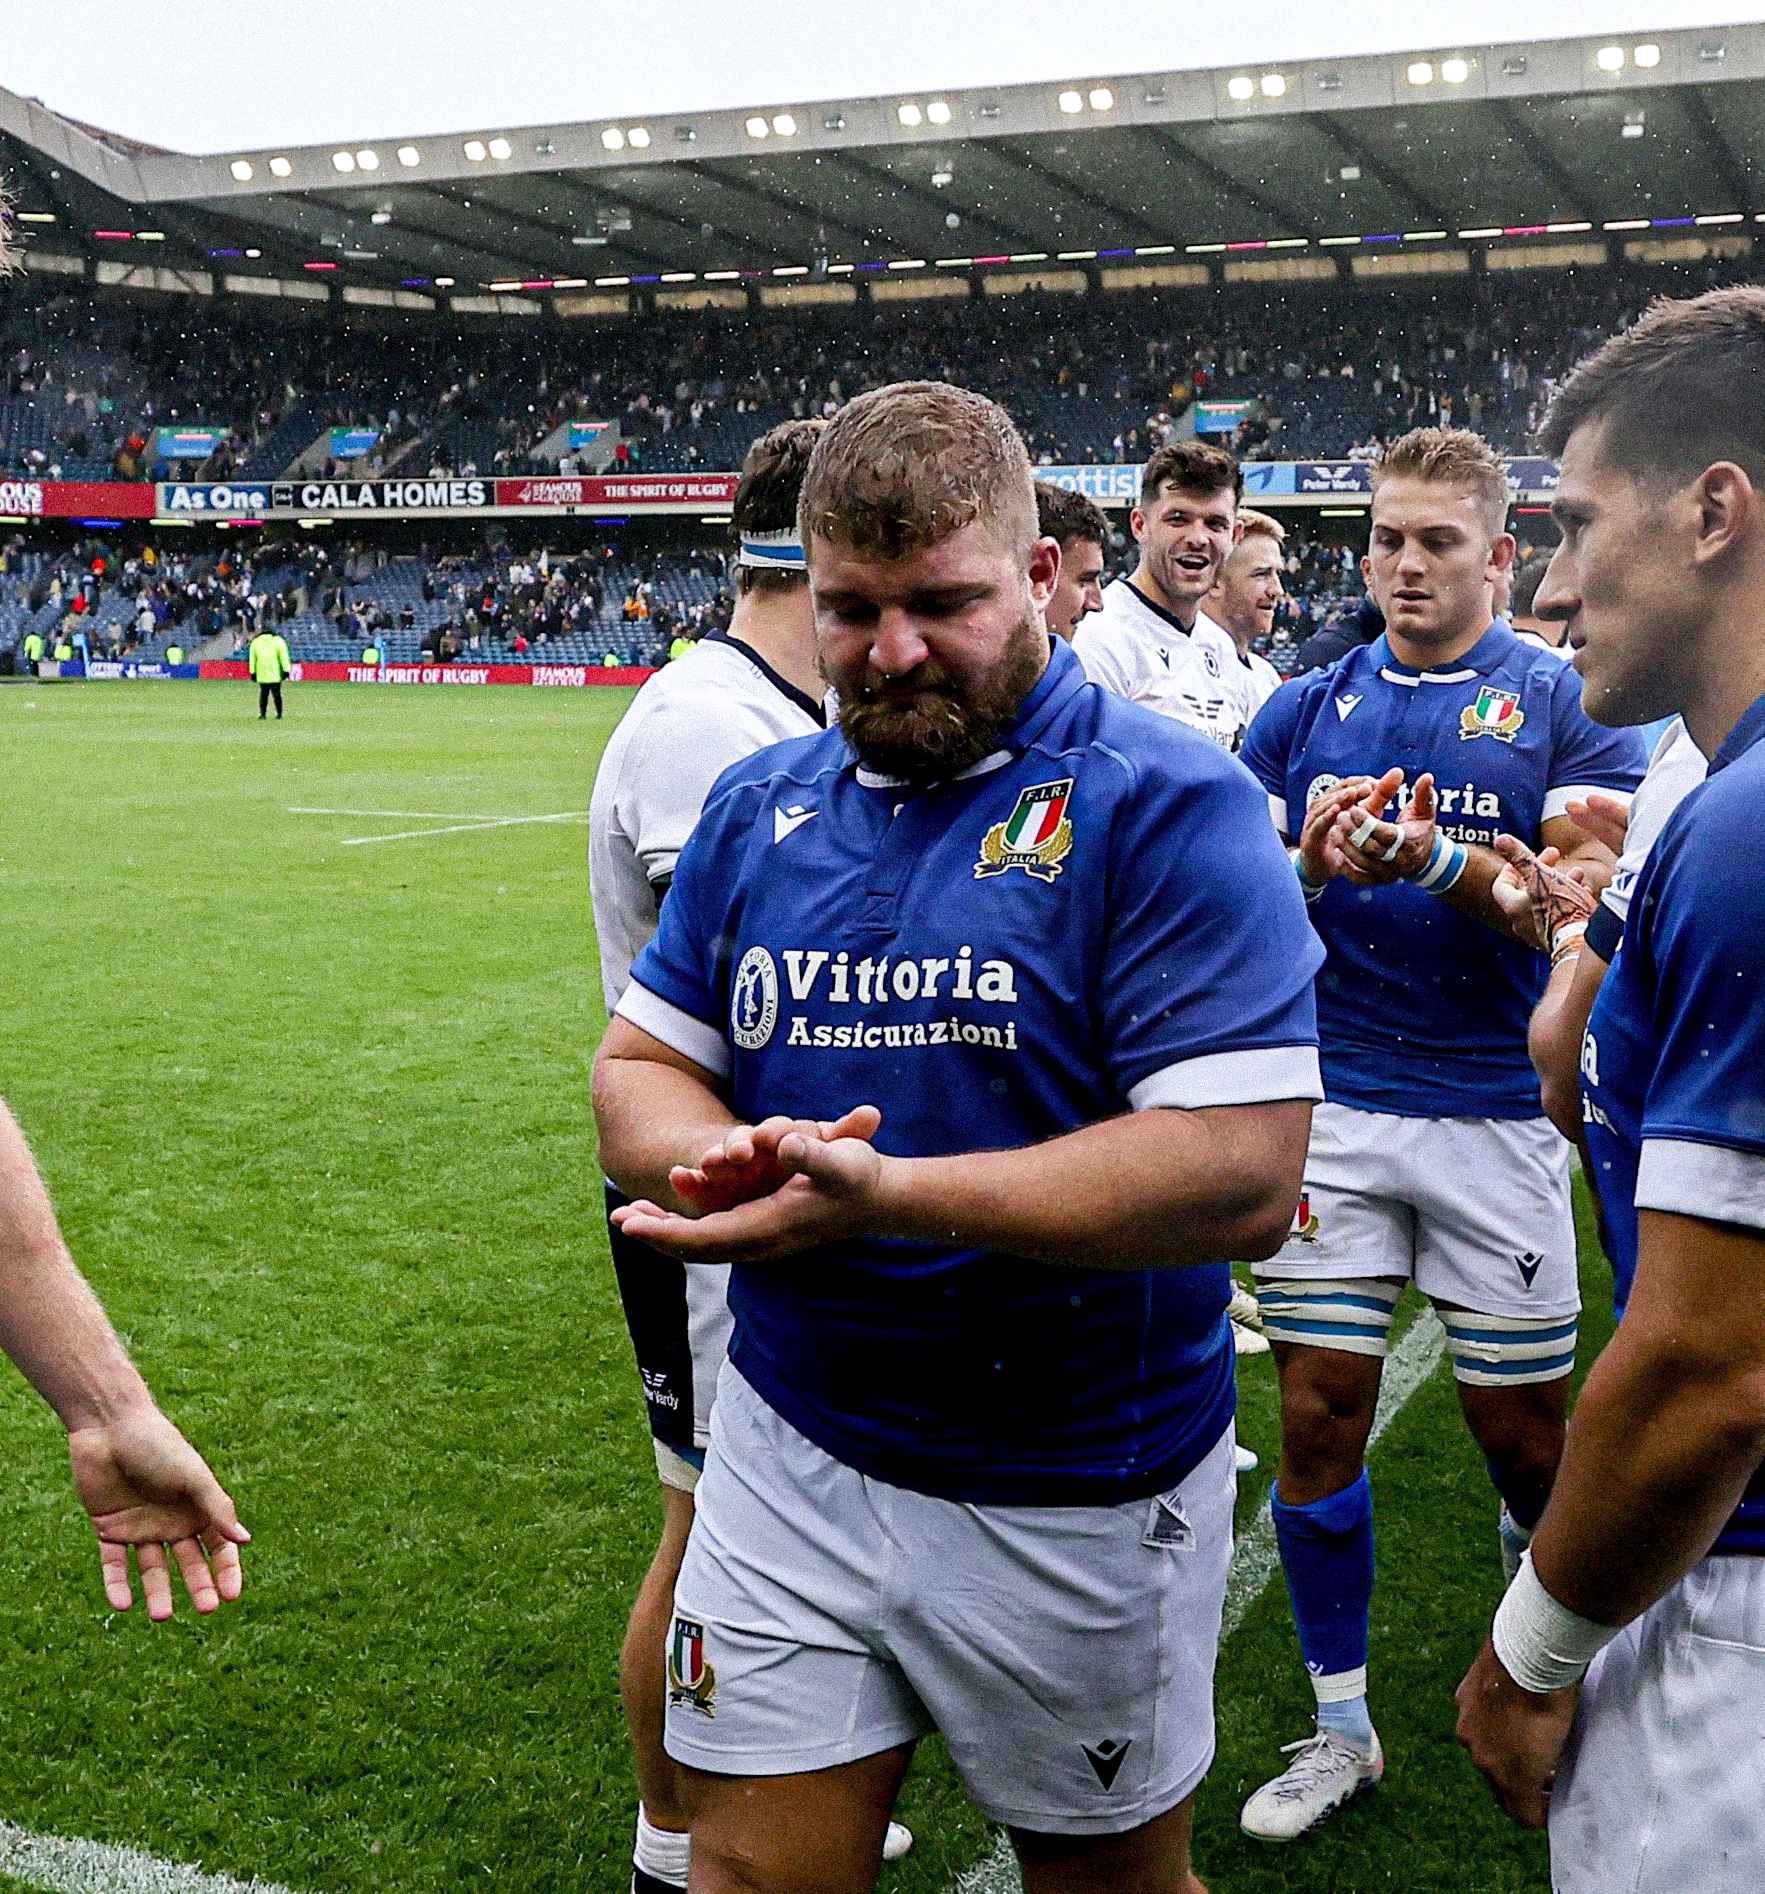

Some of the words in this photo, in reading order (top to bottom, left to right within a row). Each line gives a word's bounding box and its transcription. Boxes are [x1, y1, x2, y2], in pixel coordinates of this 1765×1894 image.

[171, 486, 206, 509] As
[210, 485, 266, 509] One
[301, 484, 377, 508] CALA
[384, 481, 486, 507] HOMES
[604, 485, 628, 497] THE
[630, 484, 667, 497] SPIRIT
[669, 484, 685, 496] OF
[687, 483, 728, 496] RUGBY
[347, 668, 376, 682] THE
[378, 668, 421, 683] SPIRIT
[422, 669, 441, 683] OF
[443, 669, 490, 684] RUGBY
[1025, 785, 1065, 801] F.I.R.
[1001, 855, 1038, 865] ITALIA
[782, 946, 1018, 1004] Vittoria
[787, 1016, 1018, 1050] Assicurazioni
